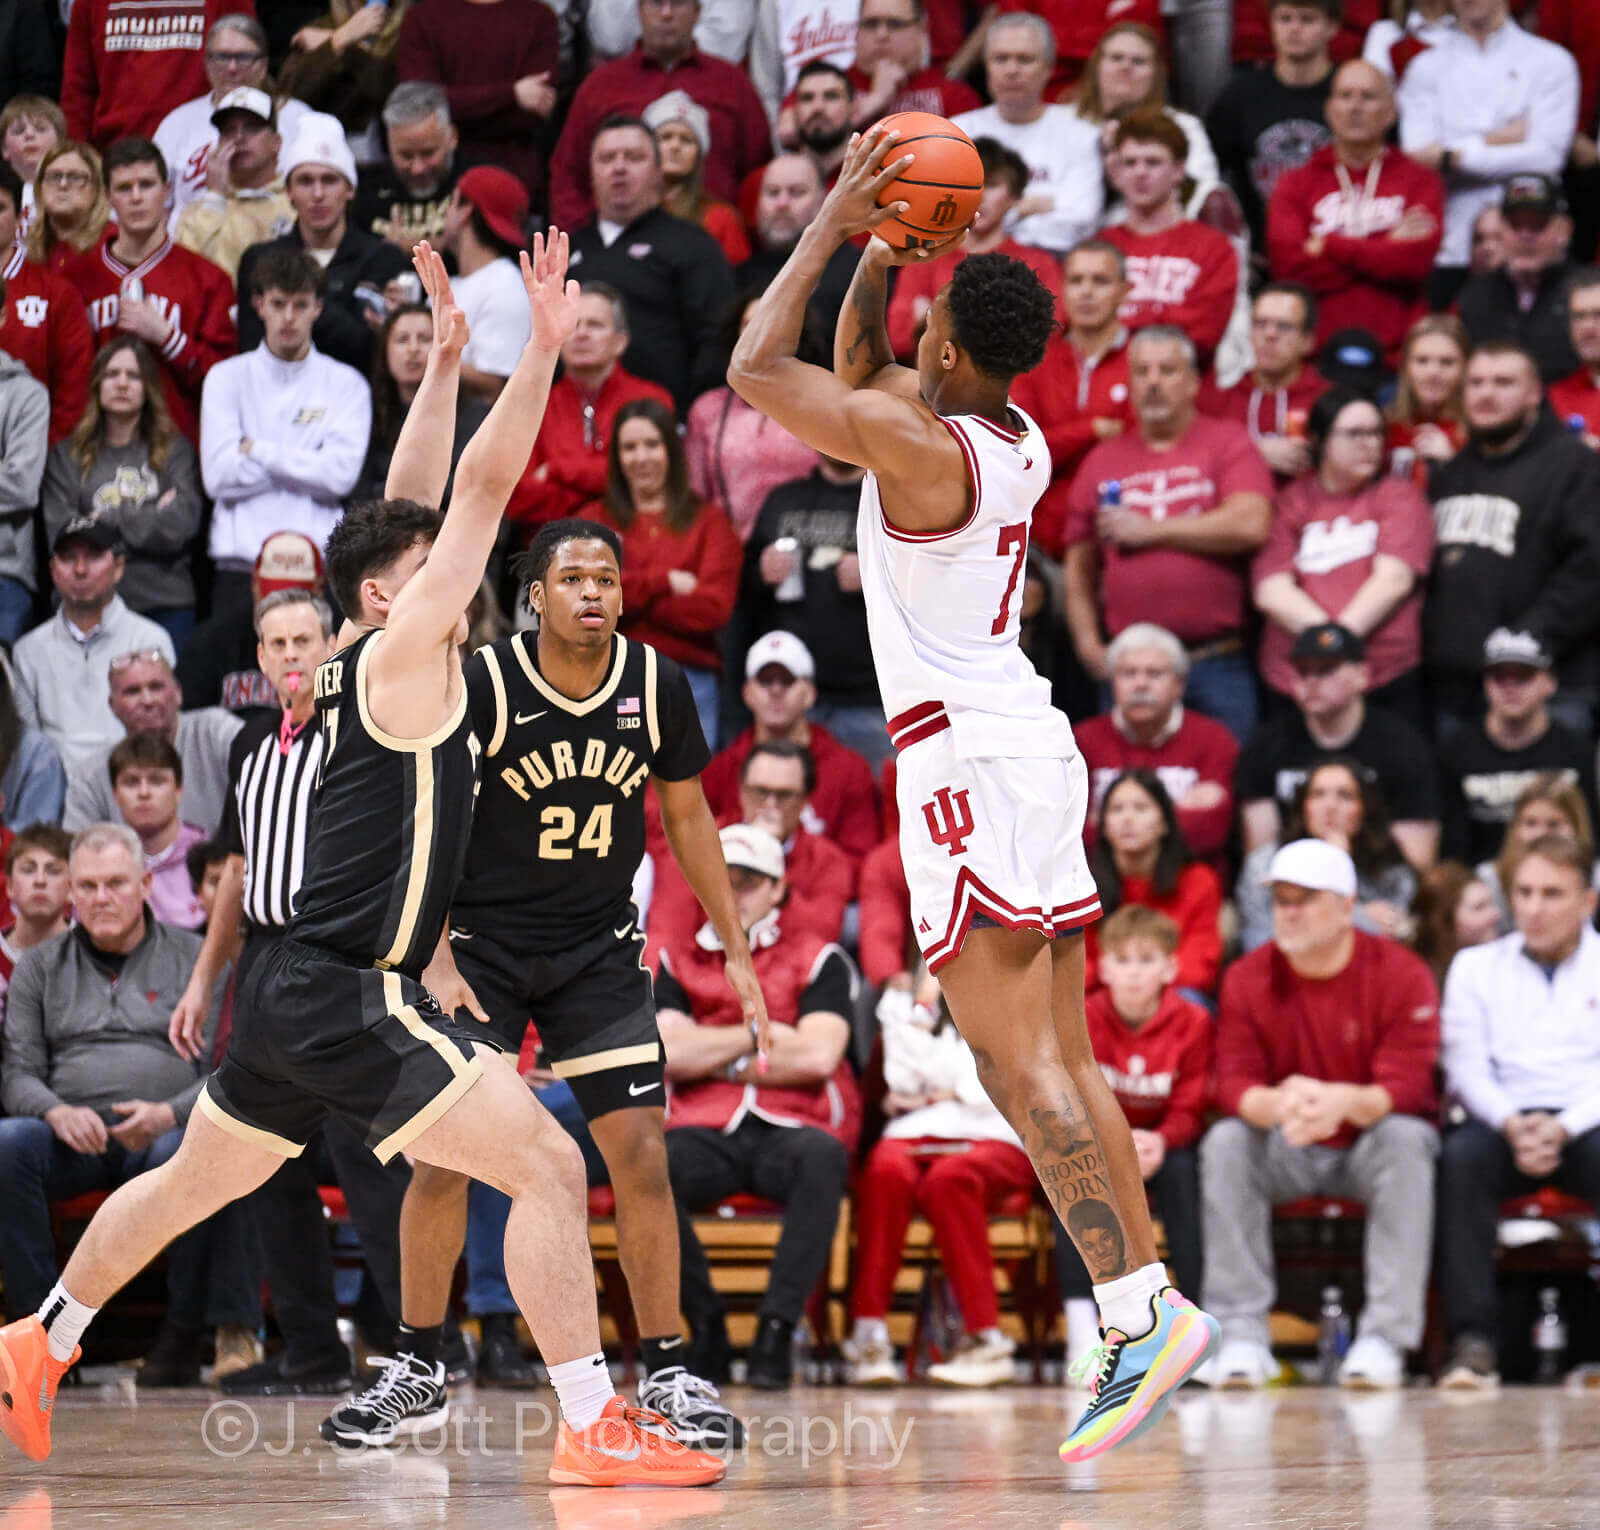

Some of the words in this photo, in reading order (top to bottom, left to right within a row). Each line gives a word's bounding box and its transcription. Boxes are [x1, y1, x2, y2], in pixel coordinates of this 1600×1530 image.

[991, 521, 1027, 636] 7
[501, 738, 650, 802] PURDUE
[538, 803, 614, 861] 24
